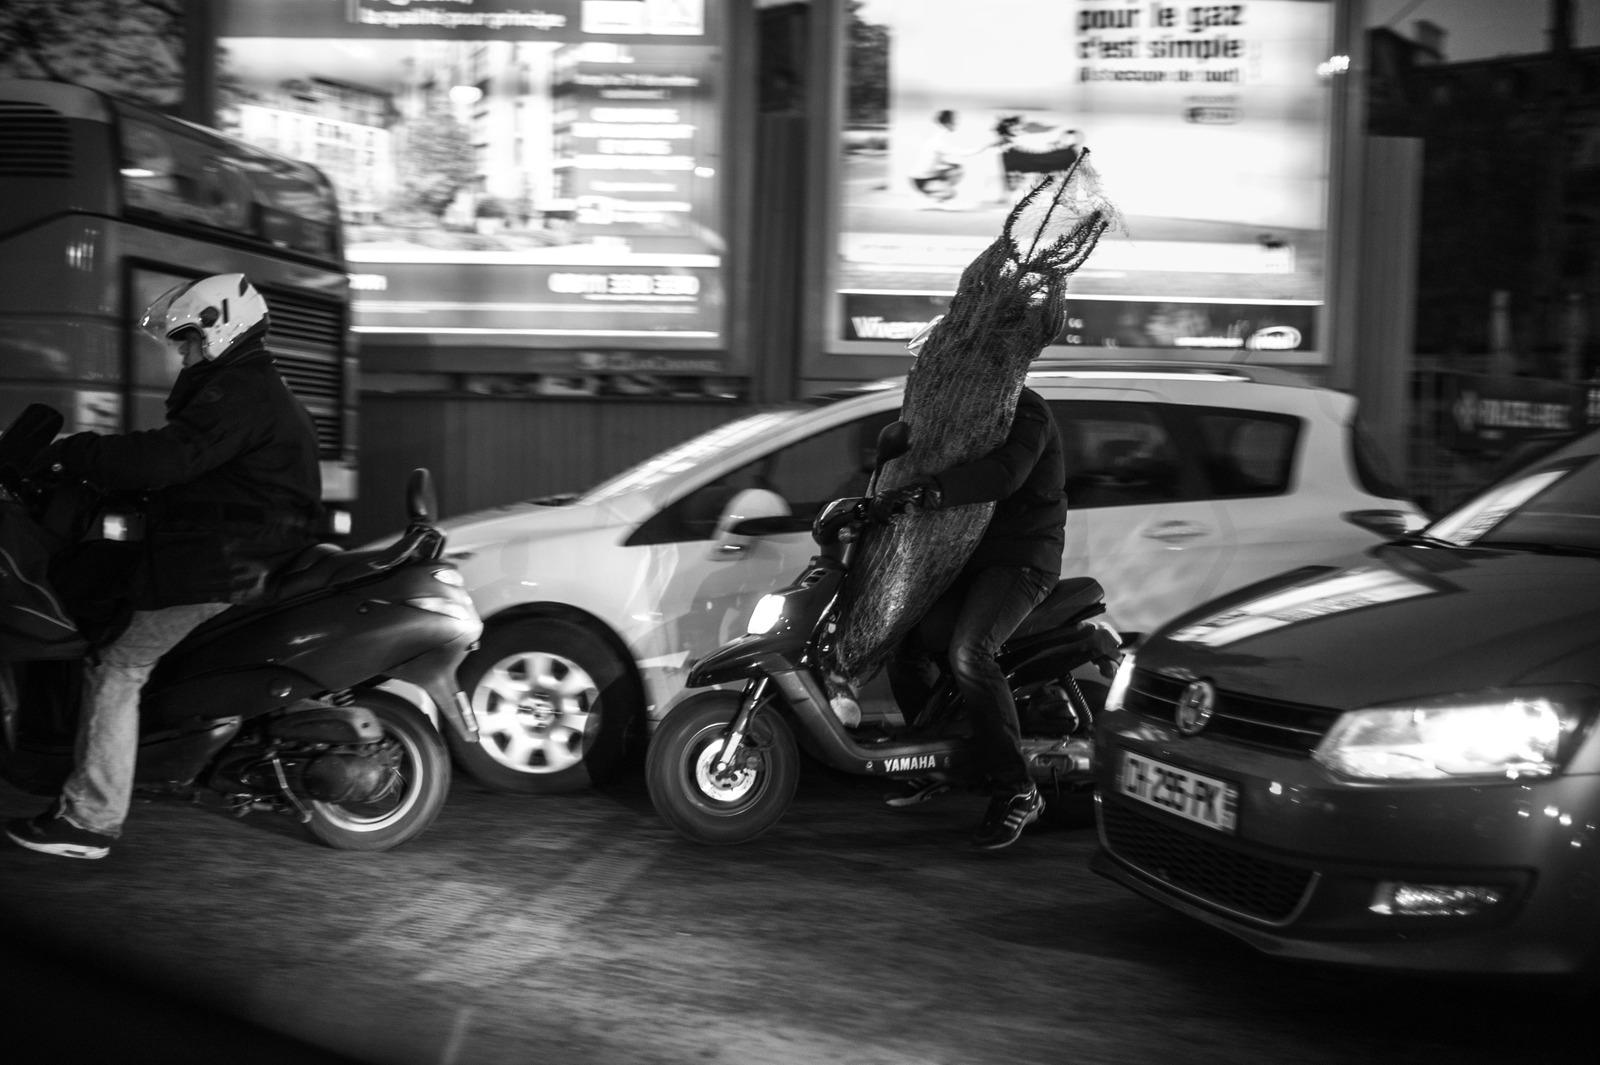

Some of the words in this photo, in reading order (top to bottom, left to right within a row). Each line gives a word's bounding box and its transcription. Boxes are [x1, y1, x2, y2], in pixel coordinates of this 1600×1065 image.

[1076, 8, 1141, 36] pour
[1150, 2, 1180, 28] le
[1186, 5, 1246, 33] gaz
[1076, 36, 1141, 59] c'est
[1148, 34, 1245, 63] simple
[884, 755, 936, 773] YAMAHA
